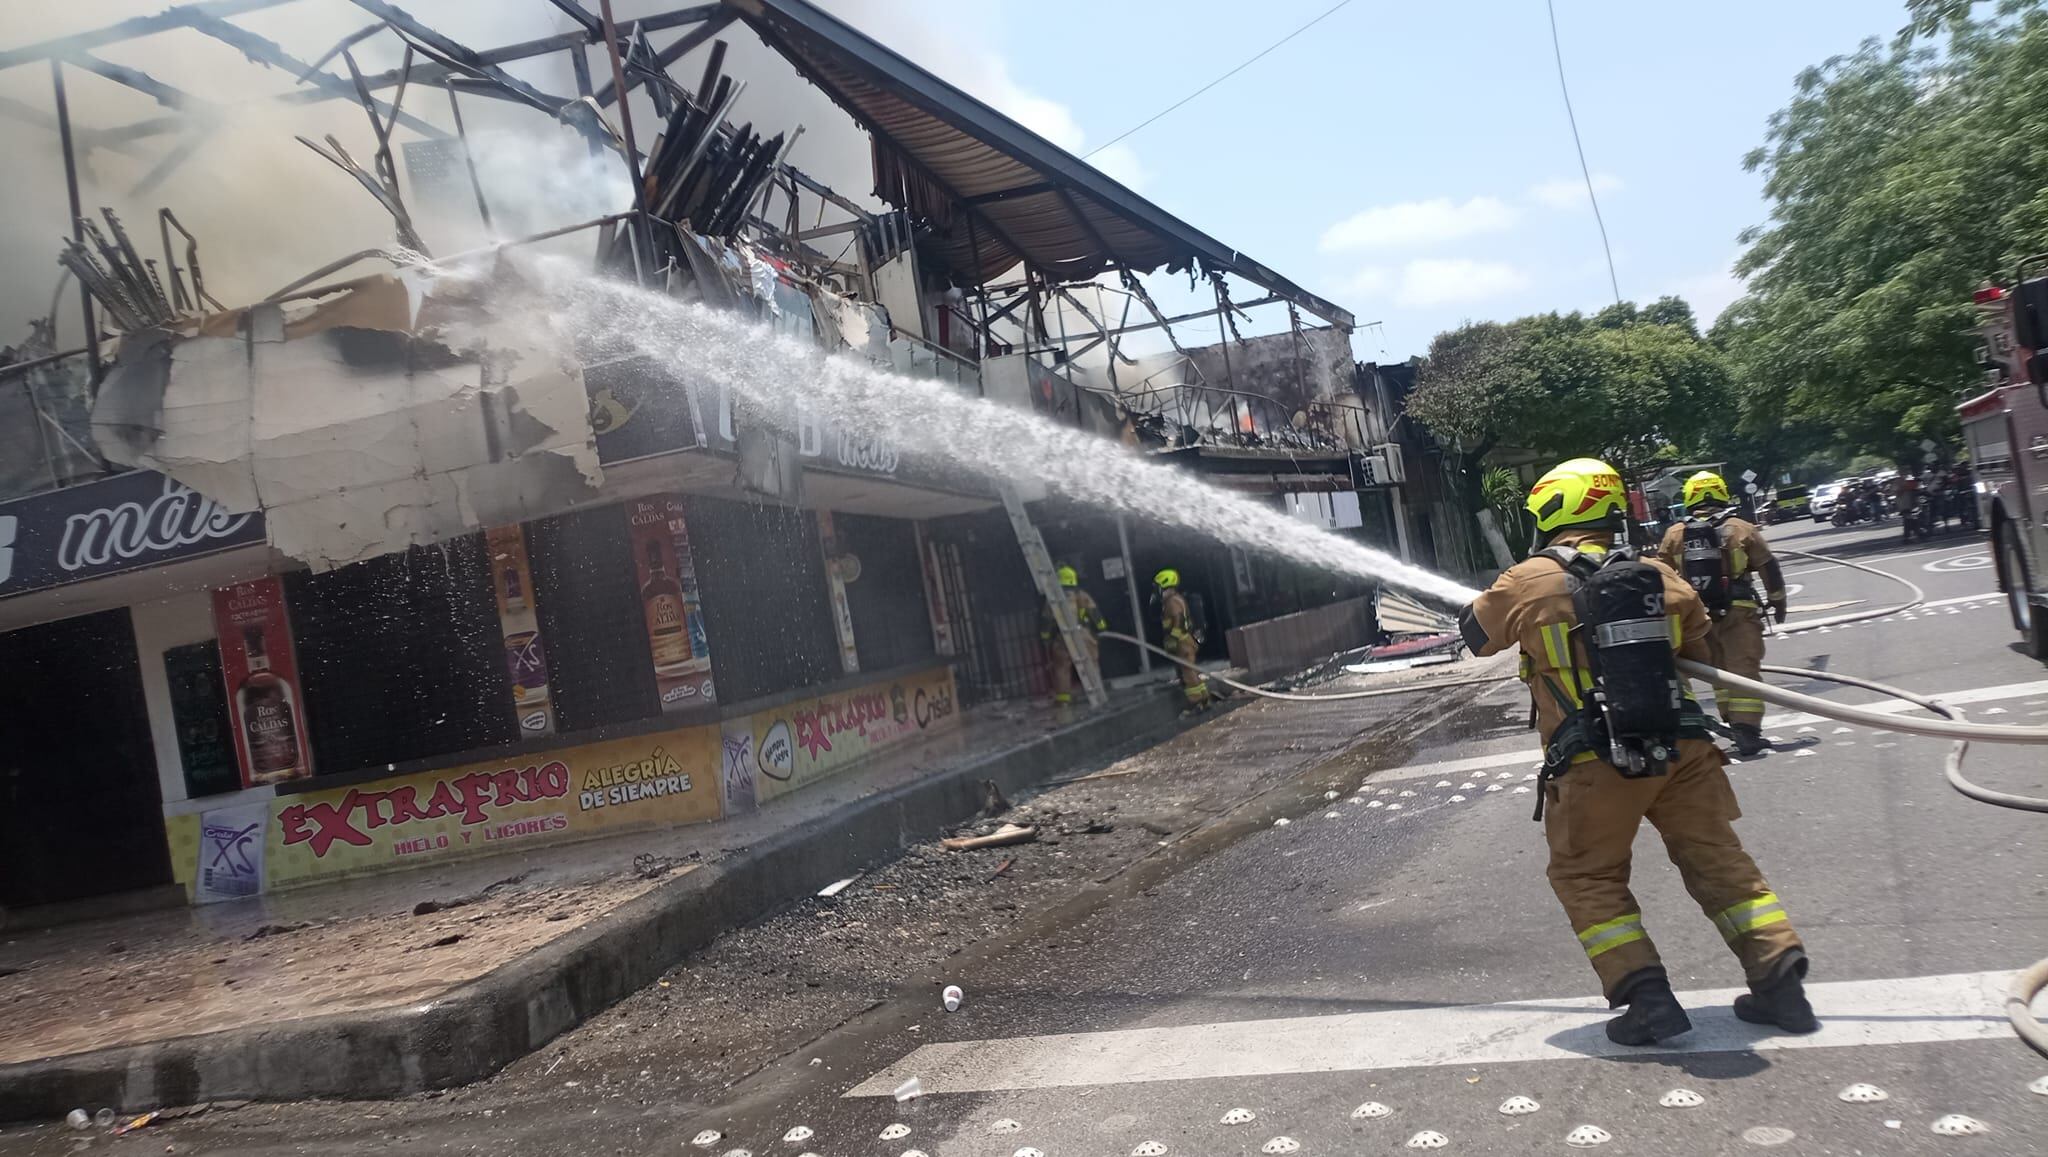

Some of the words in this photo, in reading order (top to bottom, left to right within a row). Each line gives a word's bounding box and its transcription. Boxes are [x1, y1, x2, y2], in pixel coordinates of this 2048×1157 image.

[631, 511, 665, 526] CALDAS
[513, 632, 540, 672] XS
[249, 718, 289, 733] CALDAS
[914, 685, 952, 728] Cristal
[582, 745, 682, 790] ALEGRÍA
[278, 761, 570, 858] EXTRAFRIO
[578, 790, 605, 811] DE
[609, 774, 692, 806] SIEMPRE
[212, 823, 258, 877] XS
[394, 836, 448, 856] HIELO
[461, 831, 473, 844] Y
[485, 816, 568, 841] LICORES
